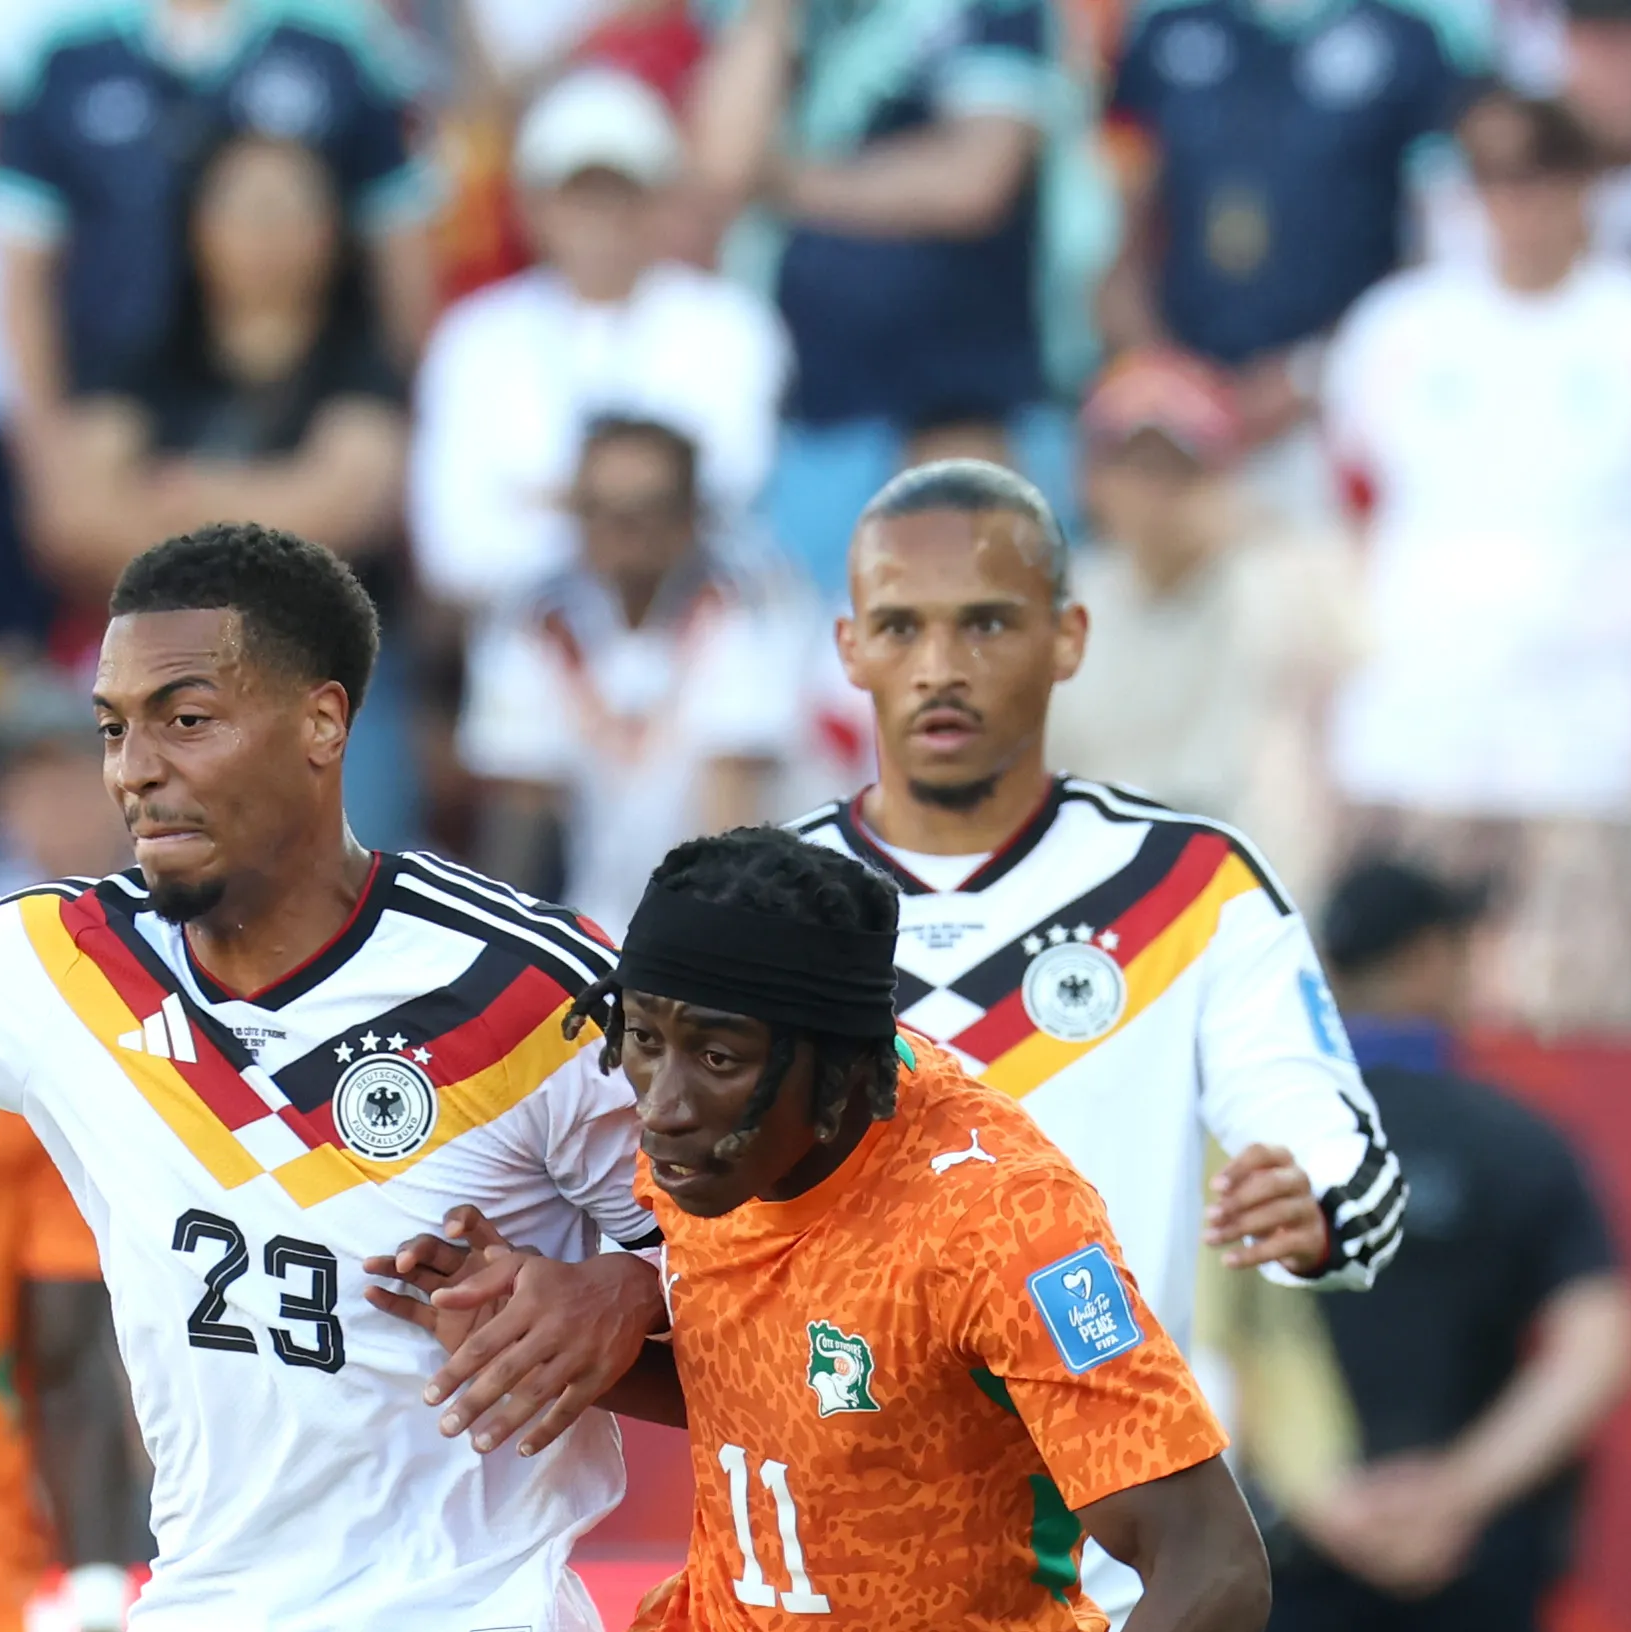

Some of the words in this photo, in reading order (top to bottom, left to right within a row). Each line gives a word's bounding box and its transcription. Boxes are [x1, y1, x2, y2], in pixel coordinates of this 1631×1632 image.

[356, 1071, 410, 1089] DEUTSCHER
[172, 1207, 345, 1375] 23
[1078, 1312, 1118, 1344] PEACE
[1095, 1334, 1120, 1351] FIFA
[718, 1442, 831, 1614] 11
